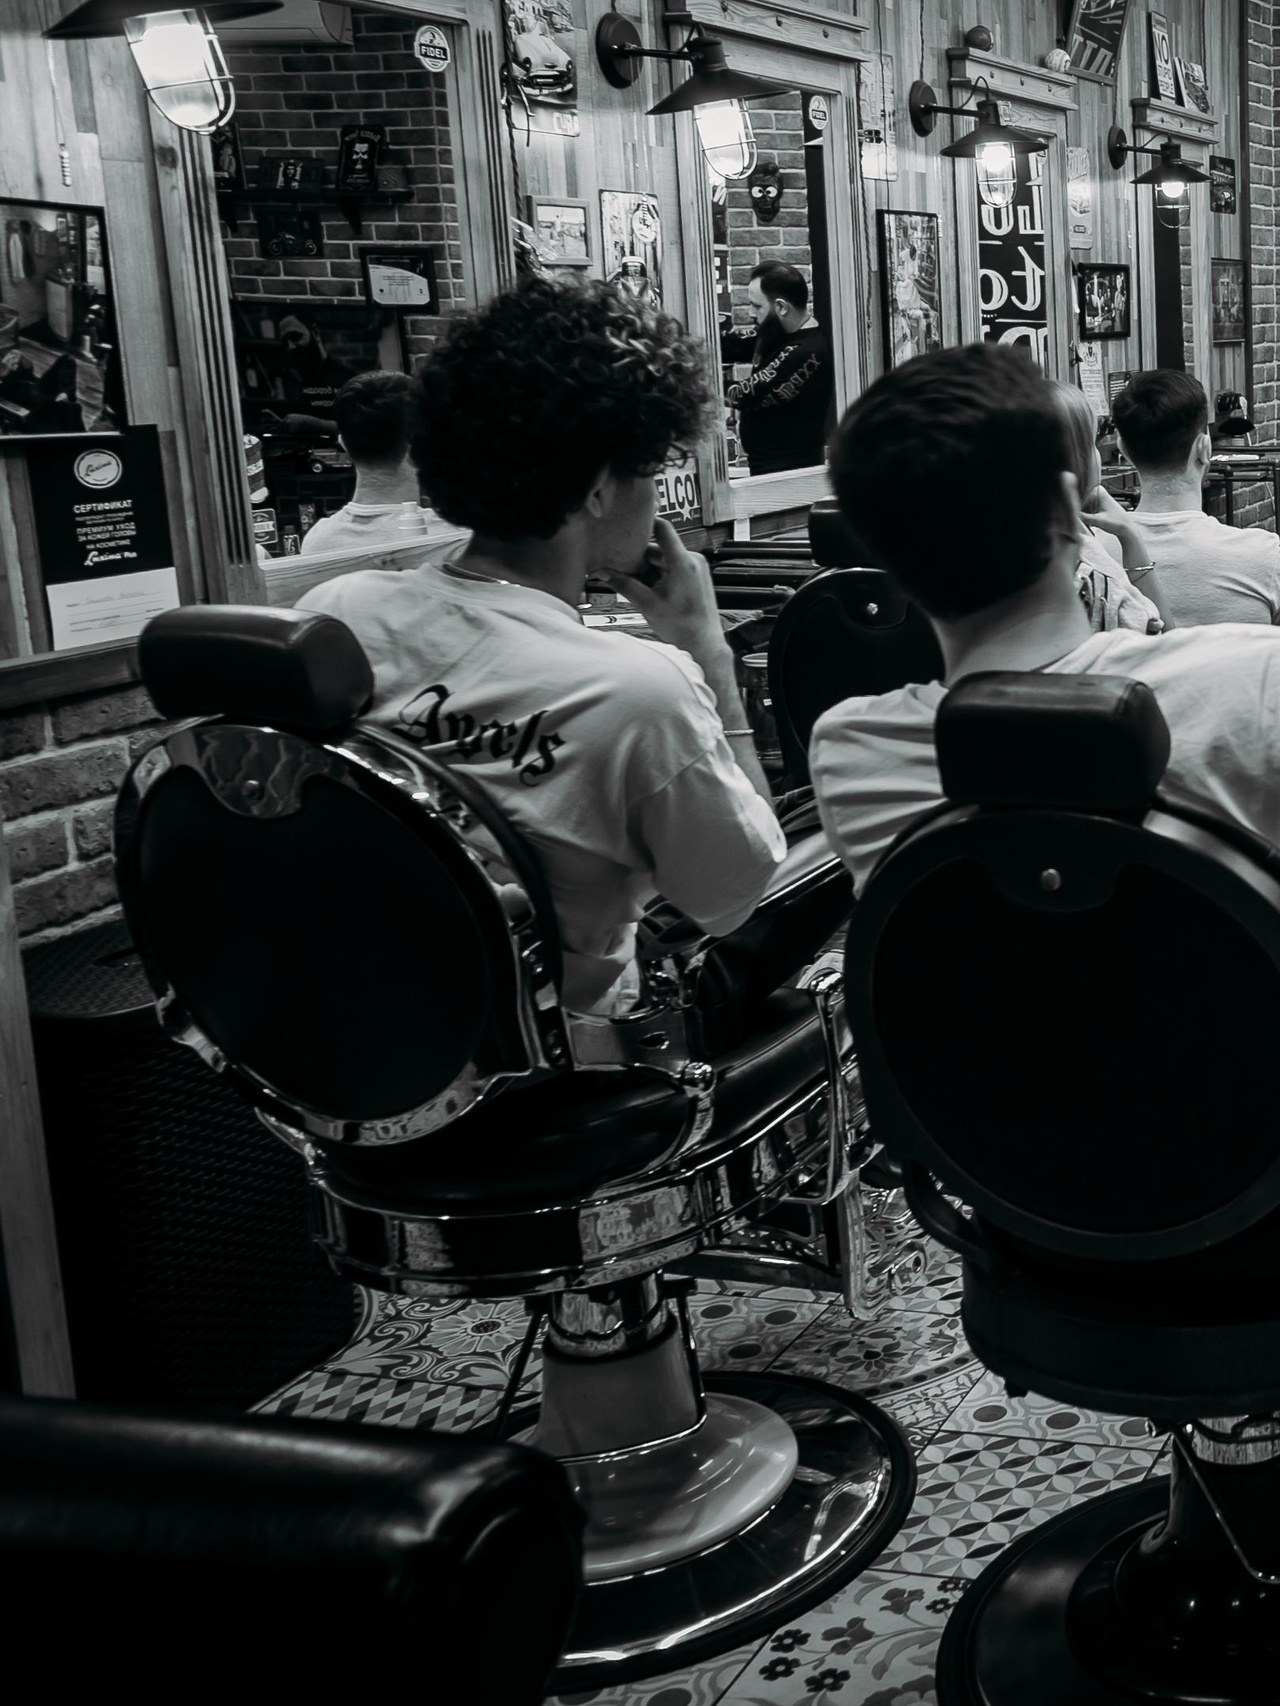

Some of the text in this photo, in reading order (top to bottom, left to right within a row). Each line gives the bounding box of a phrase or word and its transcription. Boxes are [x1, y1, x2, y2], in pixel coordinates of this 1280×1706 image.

[421, 45, 447, 59] FIDEL
[812, 109, 827, 120] FIDEL
[73, 499, 133, 514] СЕРТИФИКАТ
[76, 525, 114, 535] ПРЕМИУМ
